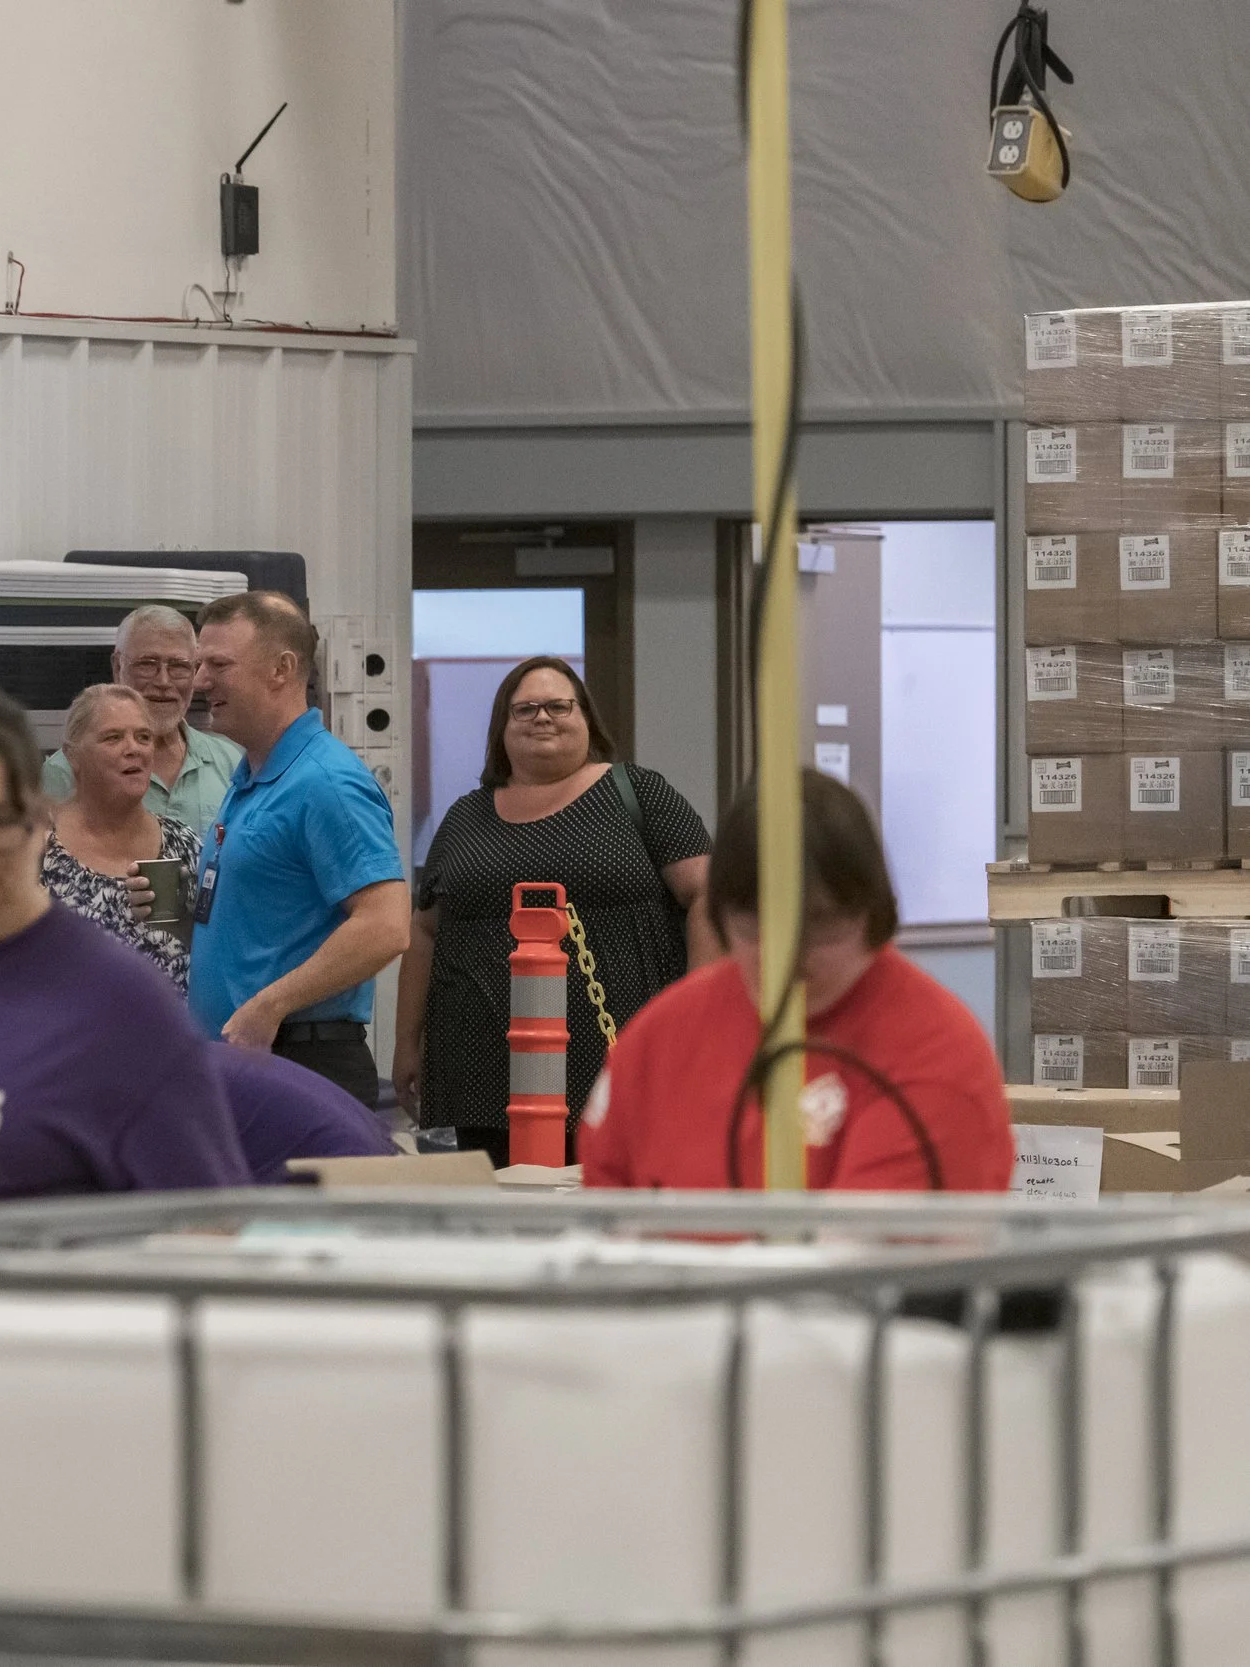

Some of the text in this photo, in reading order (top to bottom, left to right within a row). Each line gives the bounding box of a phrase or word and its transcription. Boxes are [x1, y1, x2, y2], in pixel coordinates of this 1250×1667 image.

[1034, 328, 1071, 337] 114326
[1035, 443, 1072, 451] 114326
[1034, 661, 1071, 669] 114326
